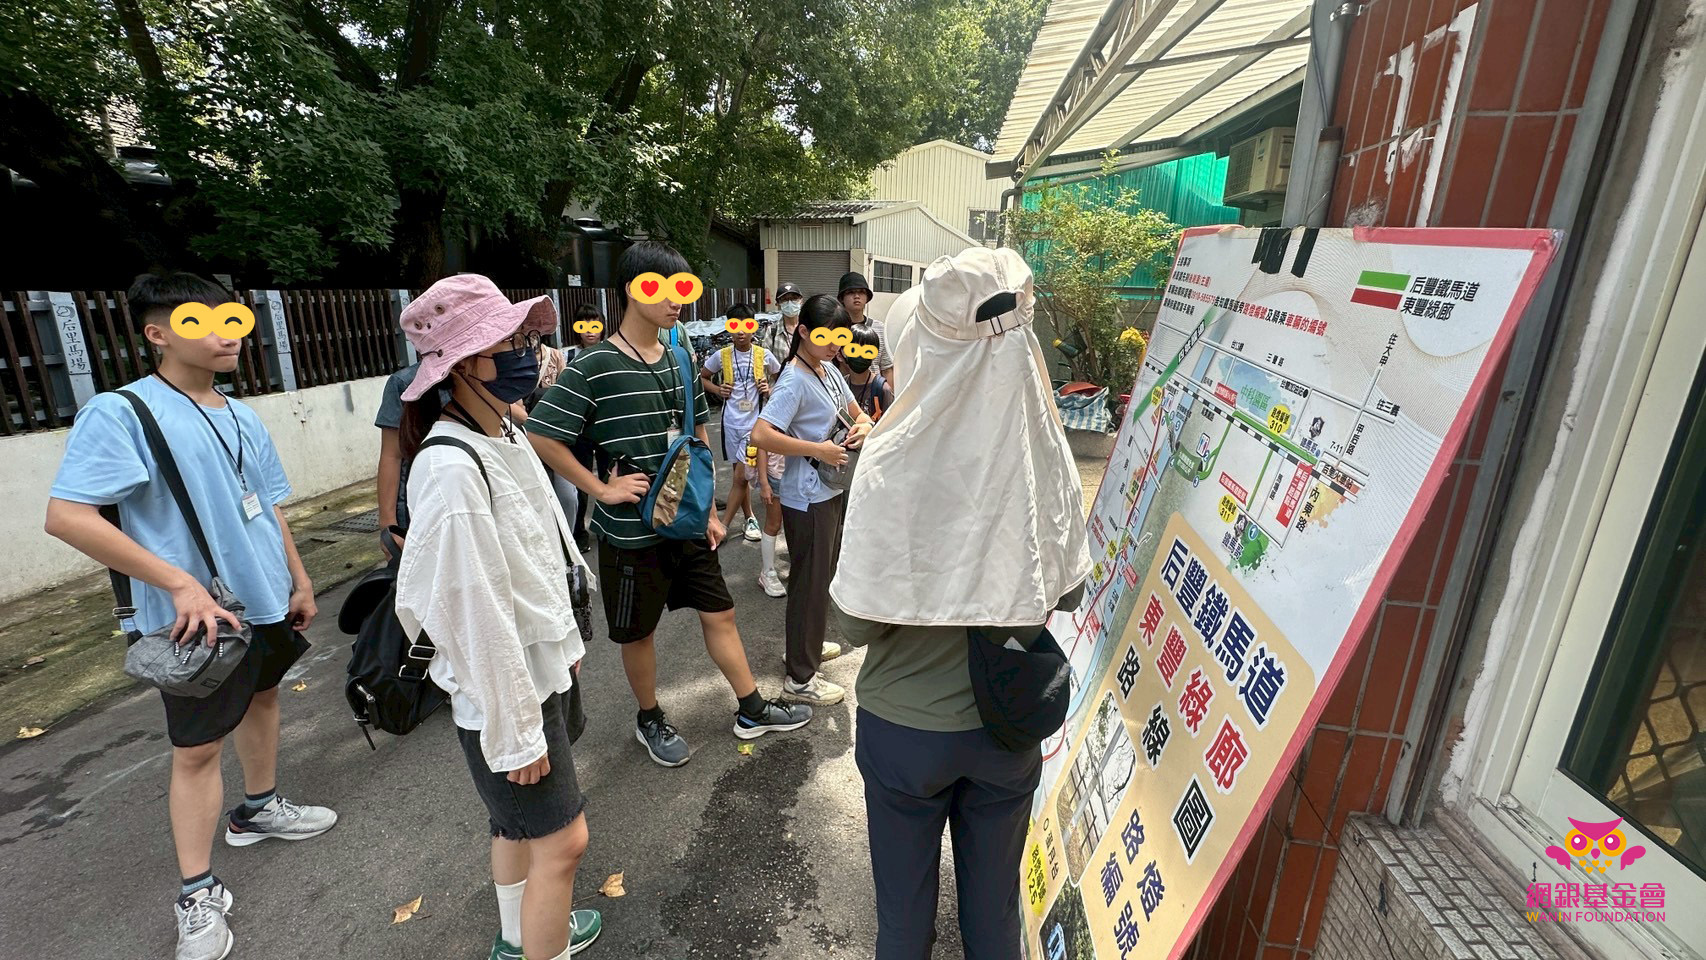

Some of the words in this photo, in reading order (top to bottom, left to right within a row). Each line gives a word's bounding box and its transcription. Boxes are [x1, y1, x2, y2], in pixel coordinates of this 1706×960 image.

[1410, 276, 1480, 302] 后豐鐵馬道
[1400, 297, 1455, 321] 東豐綠廊
[62, 319, 87, 371] 后里馬場
[275, 311, 288, 350] 后里馬場
[1379, 333, 1399, 367] 往大甲
[1376, 398, 1400, 417] 往三義
[1270, 420, 1283, 434] 310
[1346, 423, 1365, 455] 甲后路
[1220, 508, 1230, 521] 311
[1161, 538, 1284, 725] 后豐鐵馬道
[1139, 594, 1248, 789] 東豐綠廊
[1117, 645, 1213, 859] 路線圖
[1027, 868, 1037, 905] 125
